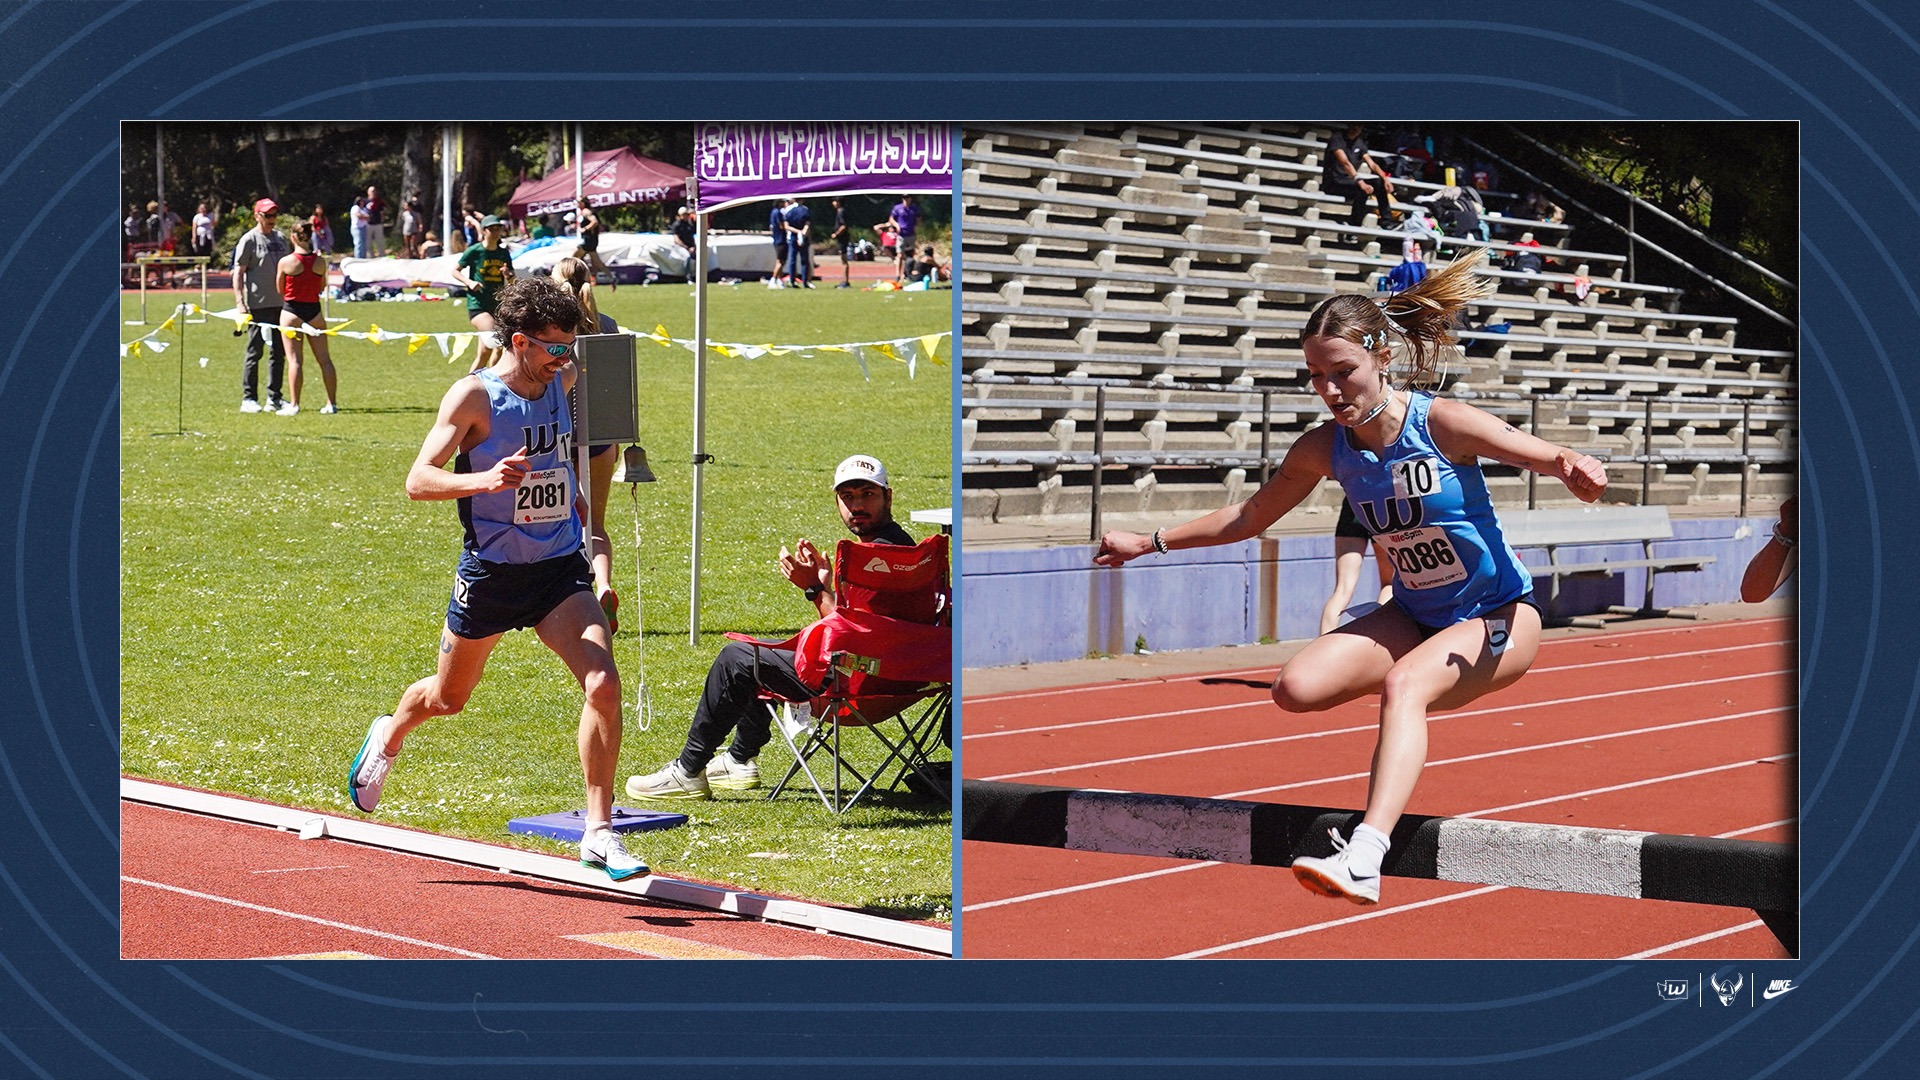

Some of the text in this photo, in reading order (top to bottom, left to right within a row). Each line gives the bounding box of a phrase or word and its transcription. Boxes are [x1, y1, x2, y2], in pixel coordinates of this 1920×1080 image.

[701, 122, 952, 181] SAN FRANCISCO
[517, 482, 566, 510] 2081
[1400, 460, 1432, 496] 10
[1388, 538, 1456, 574] 2086
[456, 578, 468, 604] 12
